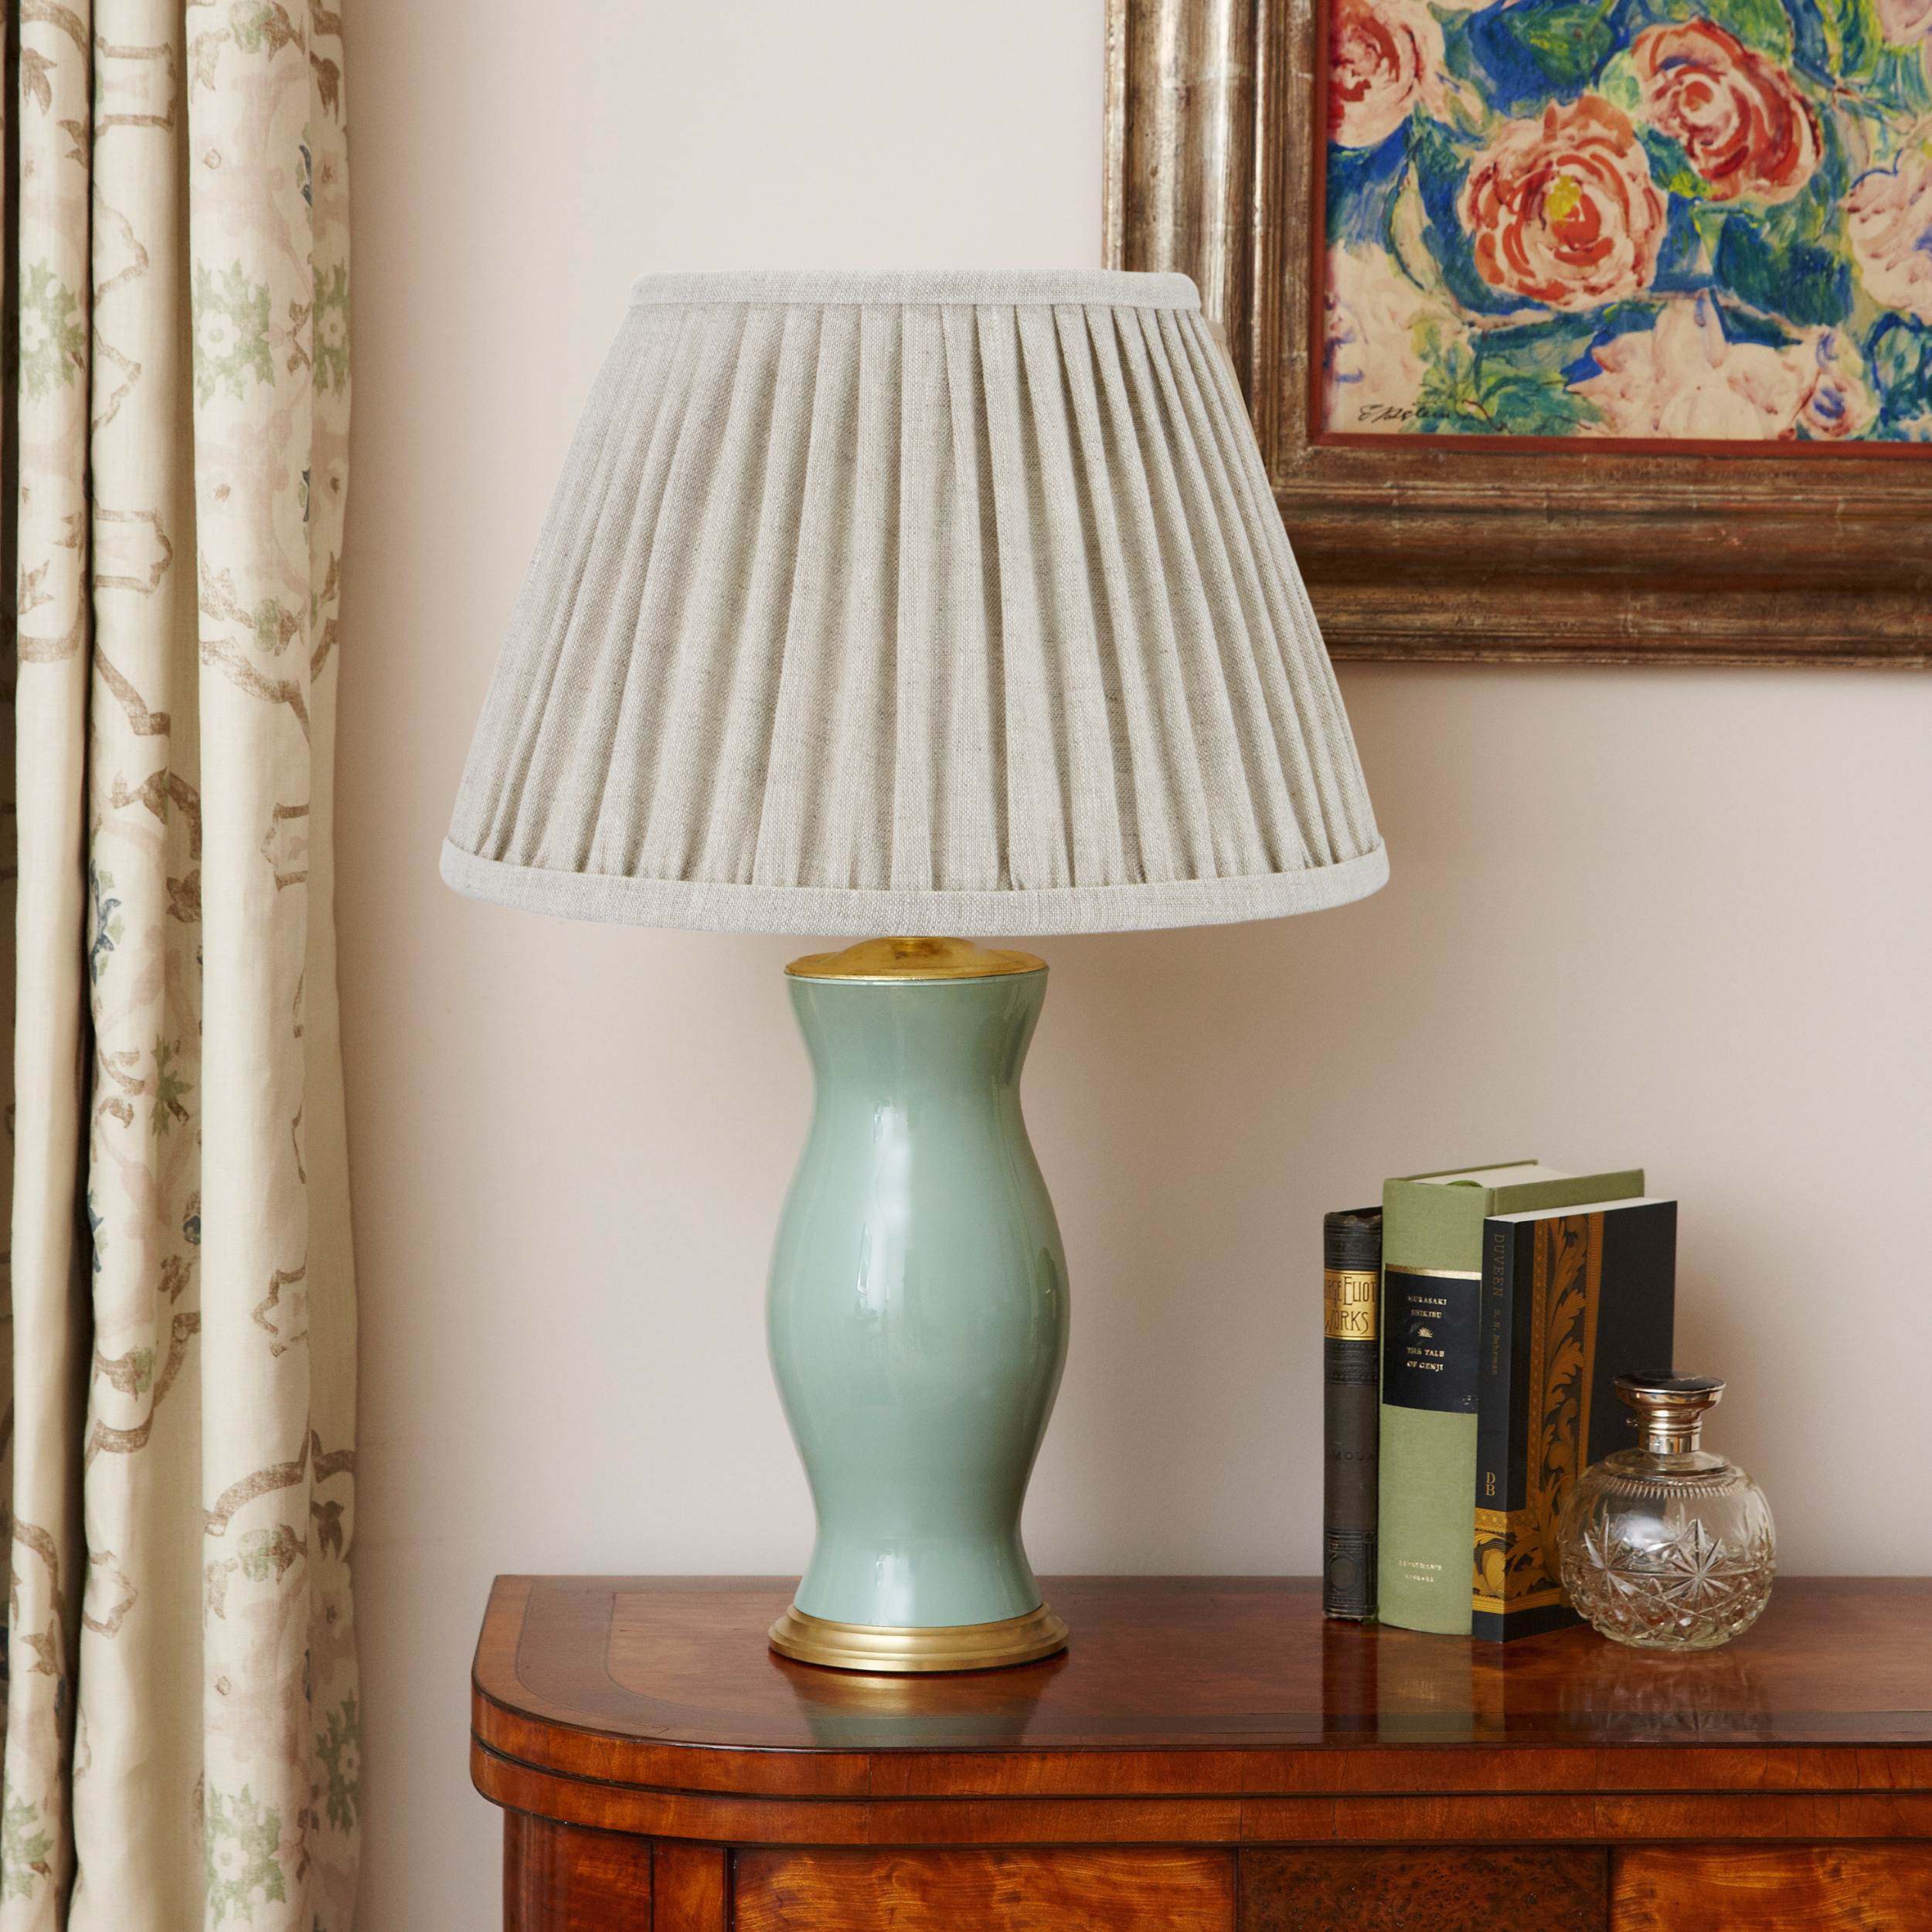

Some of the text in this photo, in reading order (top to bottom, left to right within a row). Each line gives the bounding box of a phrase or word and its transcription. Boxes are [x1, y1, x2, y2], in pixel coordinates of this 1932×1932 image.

[1493, 1234, 1505, 1298] DUVEEN
[1407, 1295, 1447, 1305] MURASAKI
[1410, 1309, 1442, 1318] SHIKIBU
[1424, 1349, 1445, 1357] TALE
[1492, 1335, 1500, 1375] Behrman
[1419, 1362, 1444, 1372] GENJI
